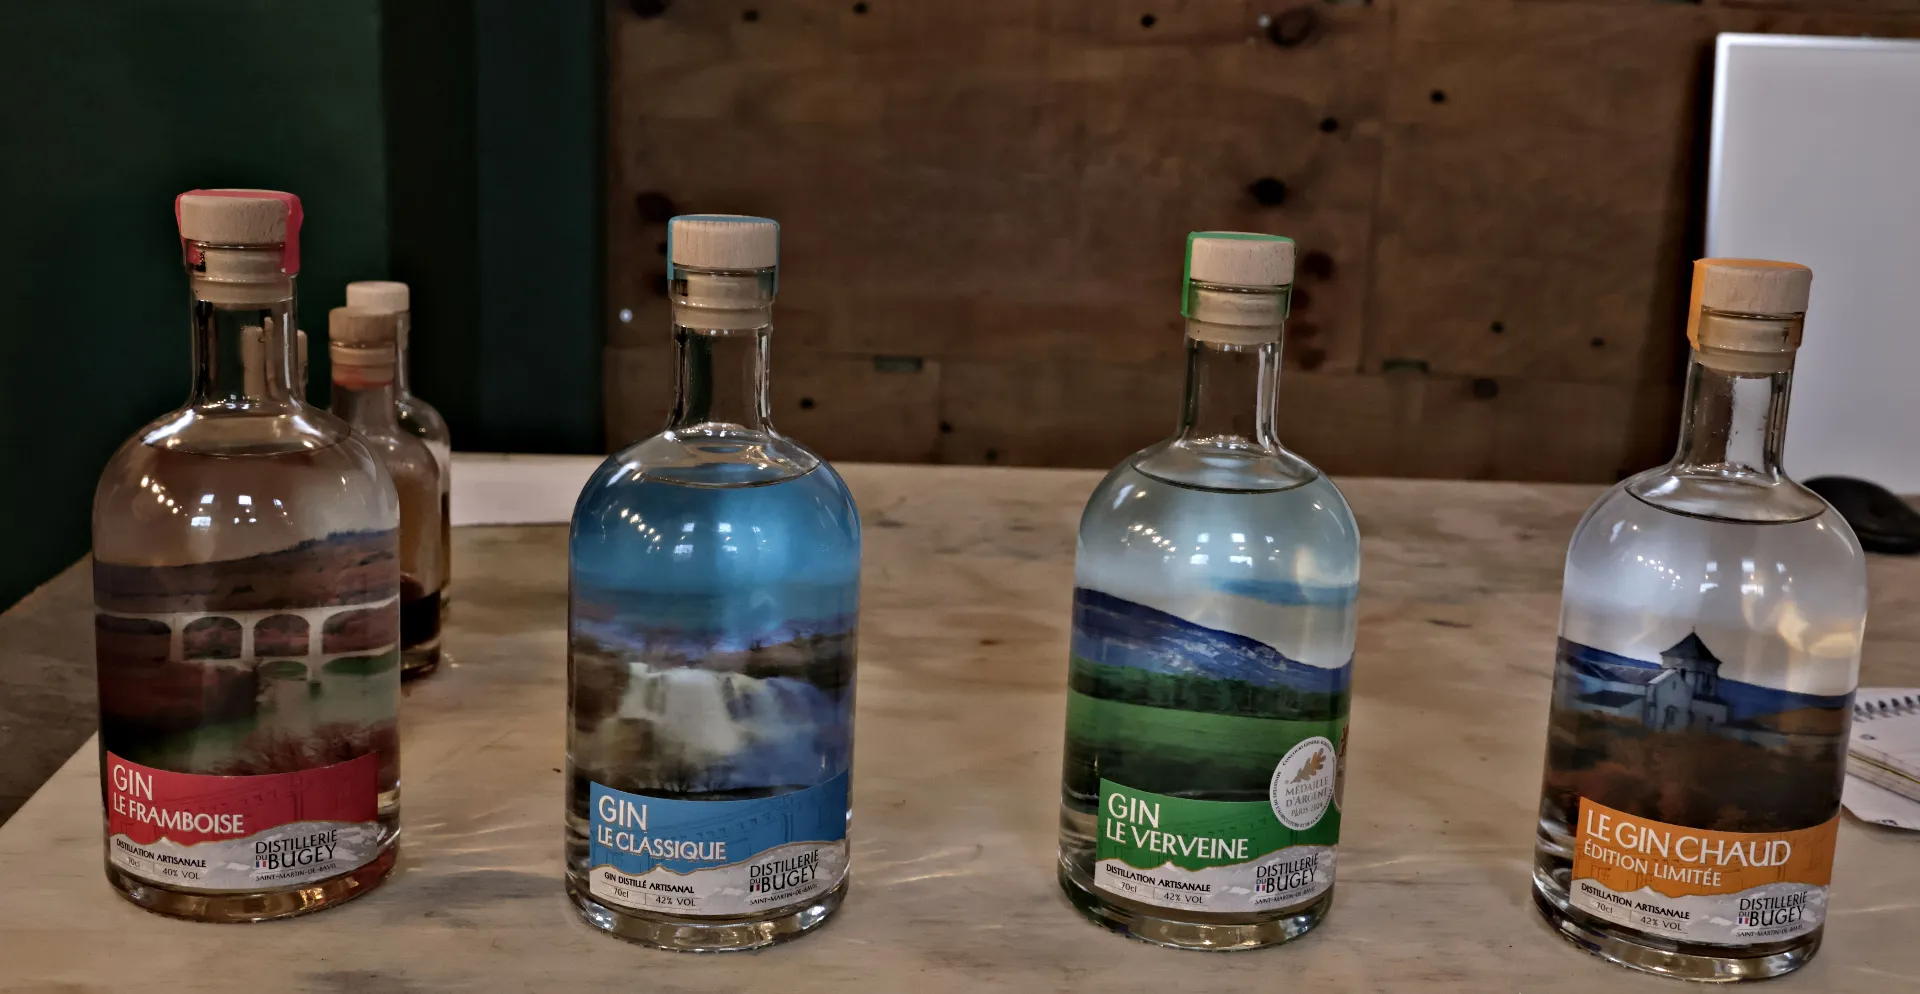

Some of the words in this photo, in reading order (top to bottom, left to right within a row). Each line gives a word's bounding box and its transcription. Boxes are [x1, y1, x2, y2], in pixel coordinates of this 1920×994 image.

[113, 764, 153, 801] GIN
[1285, 776, 1329, 797] MÉDAILLE
[1107, 793, 1160, 829] GIN
[1285, 787, 1328, 808] D'ARGENT
[113, 792, 127, 816] LE
[129, 800, 245, 834] FRAMBOISE
[599, 795, 647, 831] GIN
[255, 829, 338, 854] DISTILLERIE
[598, 824, 613, 848] LE
[616, 832, 727, 862] CLASSIQUE
[1106, 817, 1126, 845] LE
[1131, 825, 1249, 859] VERVEINE
[1586, 808, 1611, 842] LE
[1615, 822, 1670, 858] GIN
[1675, 836, 1791, 867] CHAUD
[116, 838, 155, 861] DISTILLATION
[156, 853, 207, 868] ARTISANALE
[268, 842, 337, 870] BUGEY
[750, 849, 820, 878] DISTILLERIE
[1256, 853, 1319, 878] DISTILLERIE
[1584, 838, 1648, 875] ÉDITION
[1653, 864, 1722, 887] LIMITÉE
[162, 867, 178, 878] 40%
[181, 869, 201, 880] VOL
[604, 871, 617, 882] GIN
[618, 875, 647, 889] DISTILLÉ
[648, 882, 695, 894] ARTISANAL
[761, 861, 819, 893] BUGEY
[1106, 863, 1156, 885] DISTILLATION
[1157, 879, 1211, 893] ARTISANALE
[1266, 866, 1318, 894] BUGEY
[613, 888, 629, 899] 70cl
[655, 896, 673, 905] 42%
[676, 897, 696, 907] VOL
[1121, 881, 1138, 893] 70cl
[1163, 892, 1181, 902] 42%
[1184, 894, 1204, 904] VOL
[1581, 882, 1633, 909] DISTILLATION
[1634, 902, 1690, 920] ARTISANALE
[1739, 891, 1808, 911] DISTILLERIE
[1596, 901, 1613, 914] 70cl
[1640, 915, 1659, 927] 42%
[1663, 920, 1682, 931] VOL
[1749, 904, 1806, 927] BUGEY
